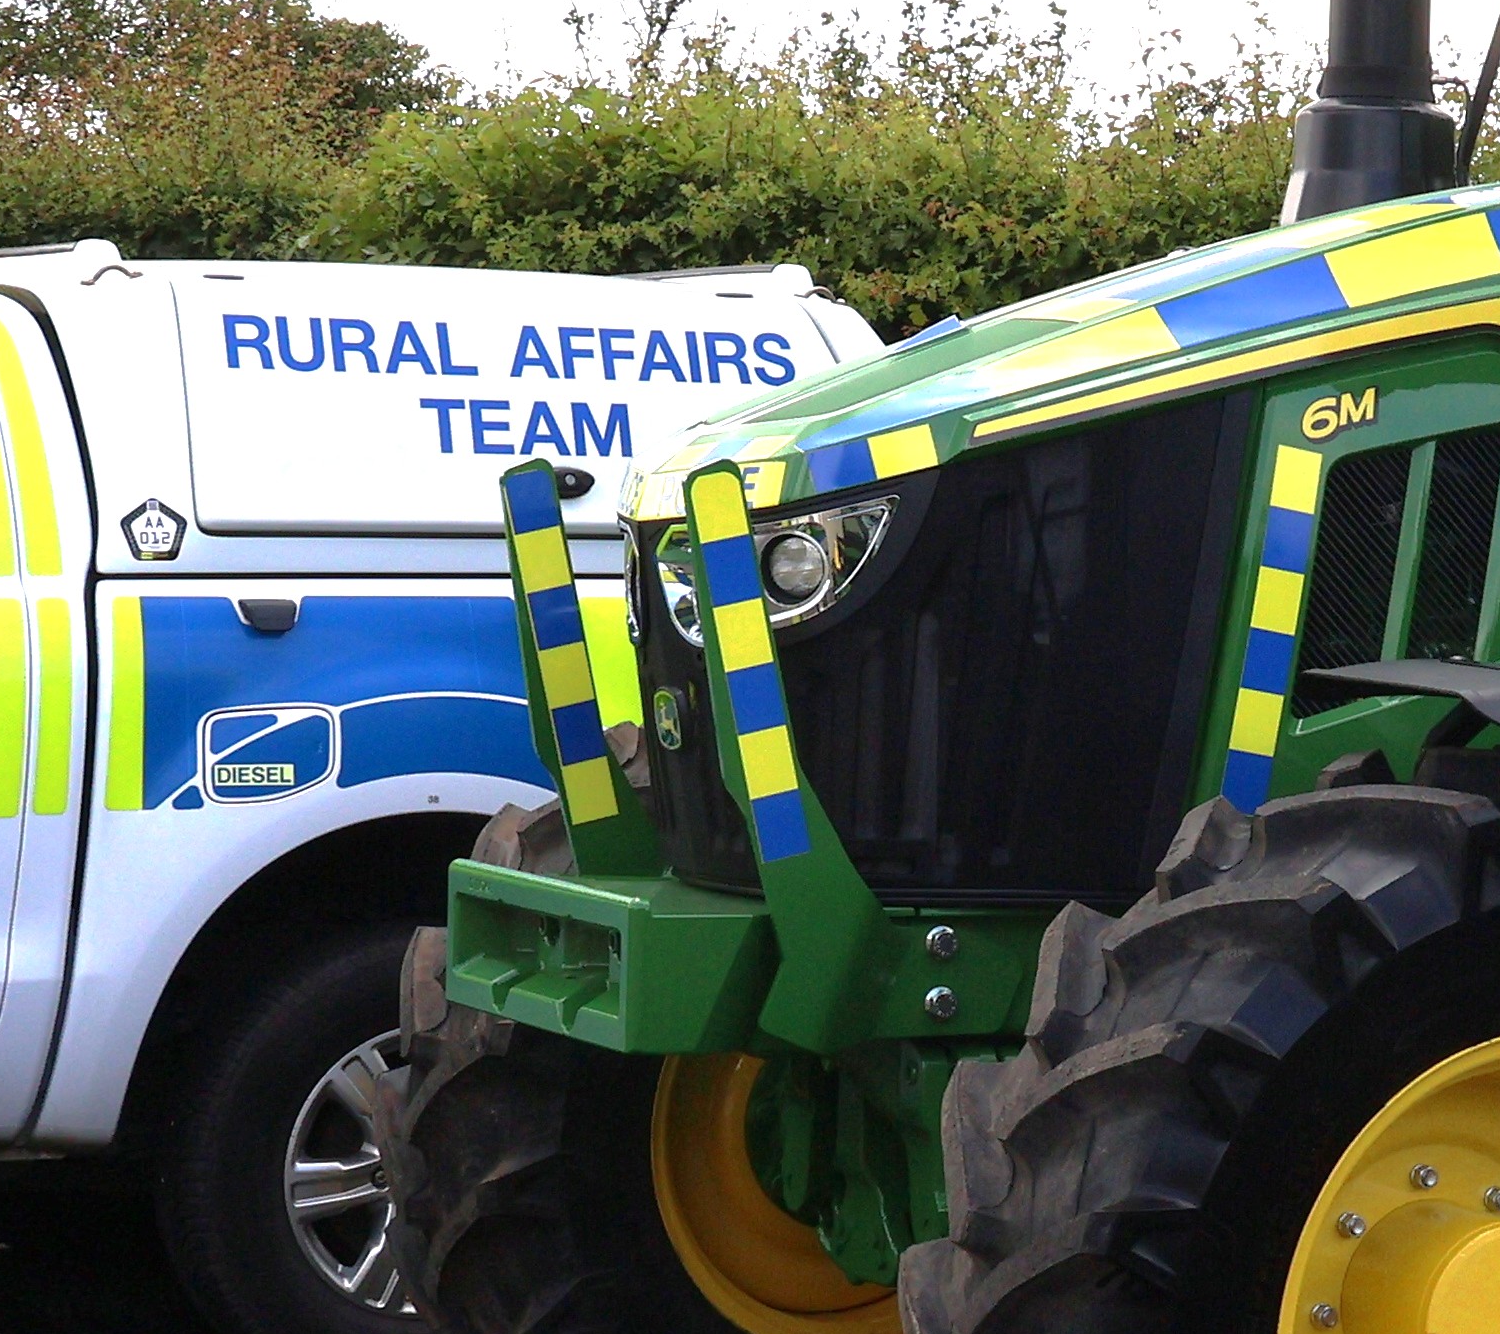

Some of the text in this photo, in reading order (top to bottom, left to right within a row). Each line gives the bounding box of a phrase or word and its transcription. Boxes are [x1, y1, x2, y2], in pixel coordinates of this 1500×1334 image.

[221, 313, 797, 386] RURAL AFFAIRS
[419, 397, 633, 457] TEAM
[1300, 387, 1377, 441] 6M
[140, 531, 171, 545] 012
[145, 516, 165, 529] AA
[217, 766, 292, 784] DIESEL
